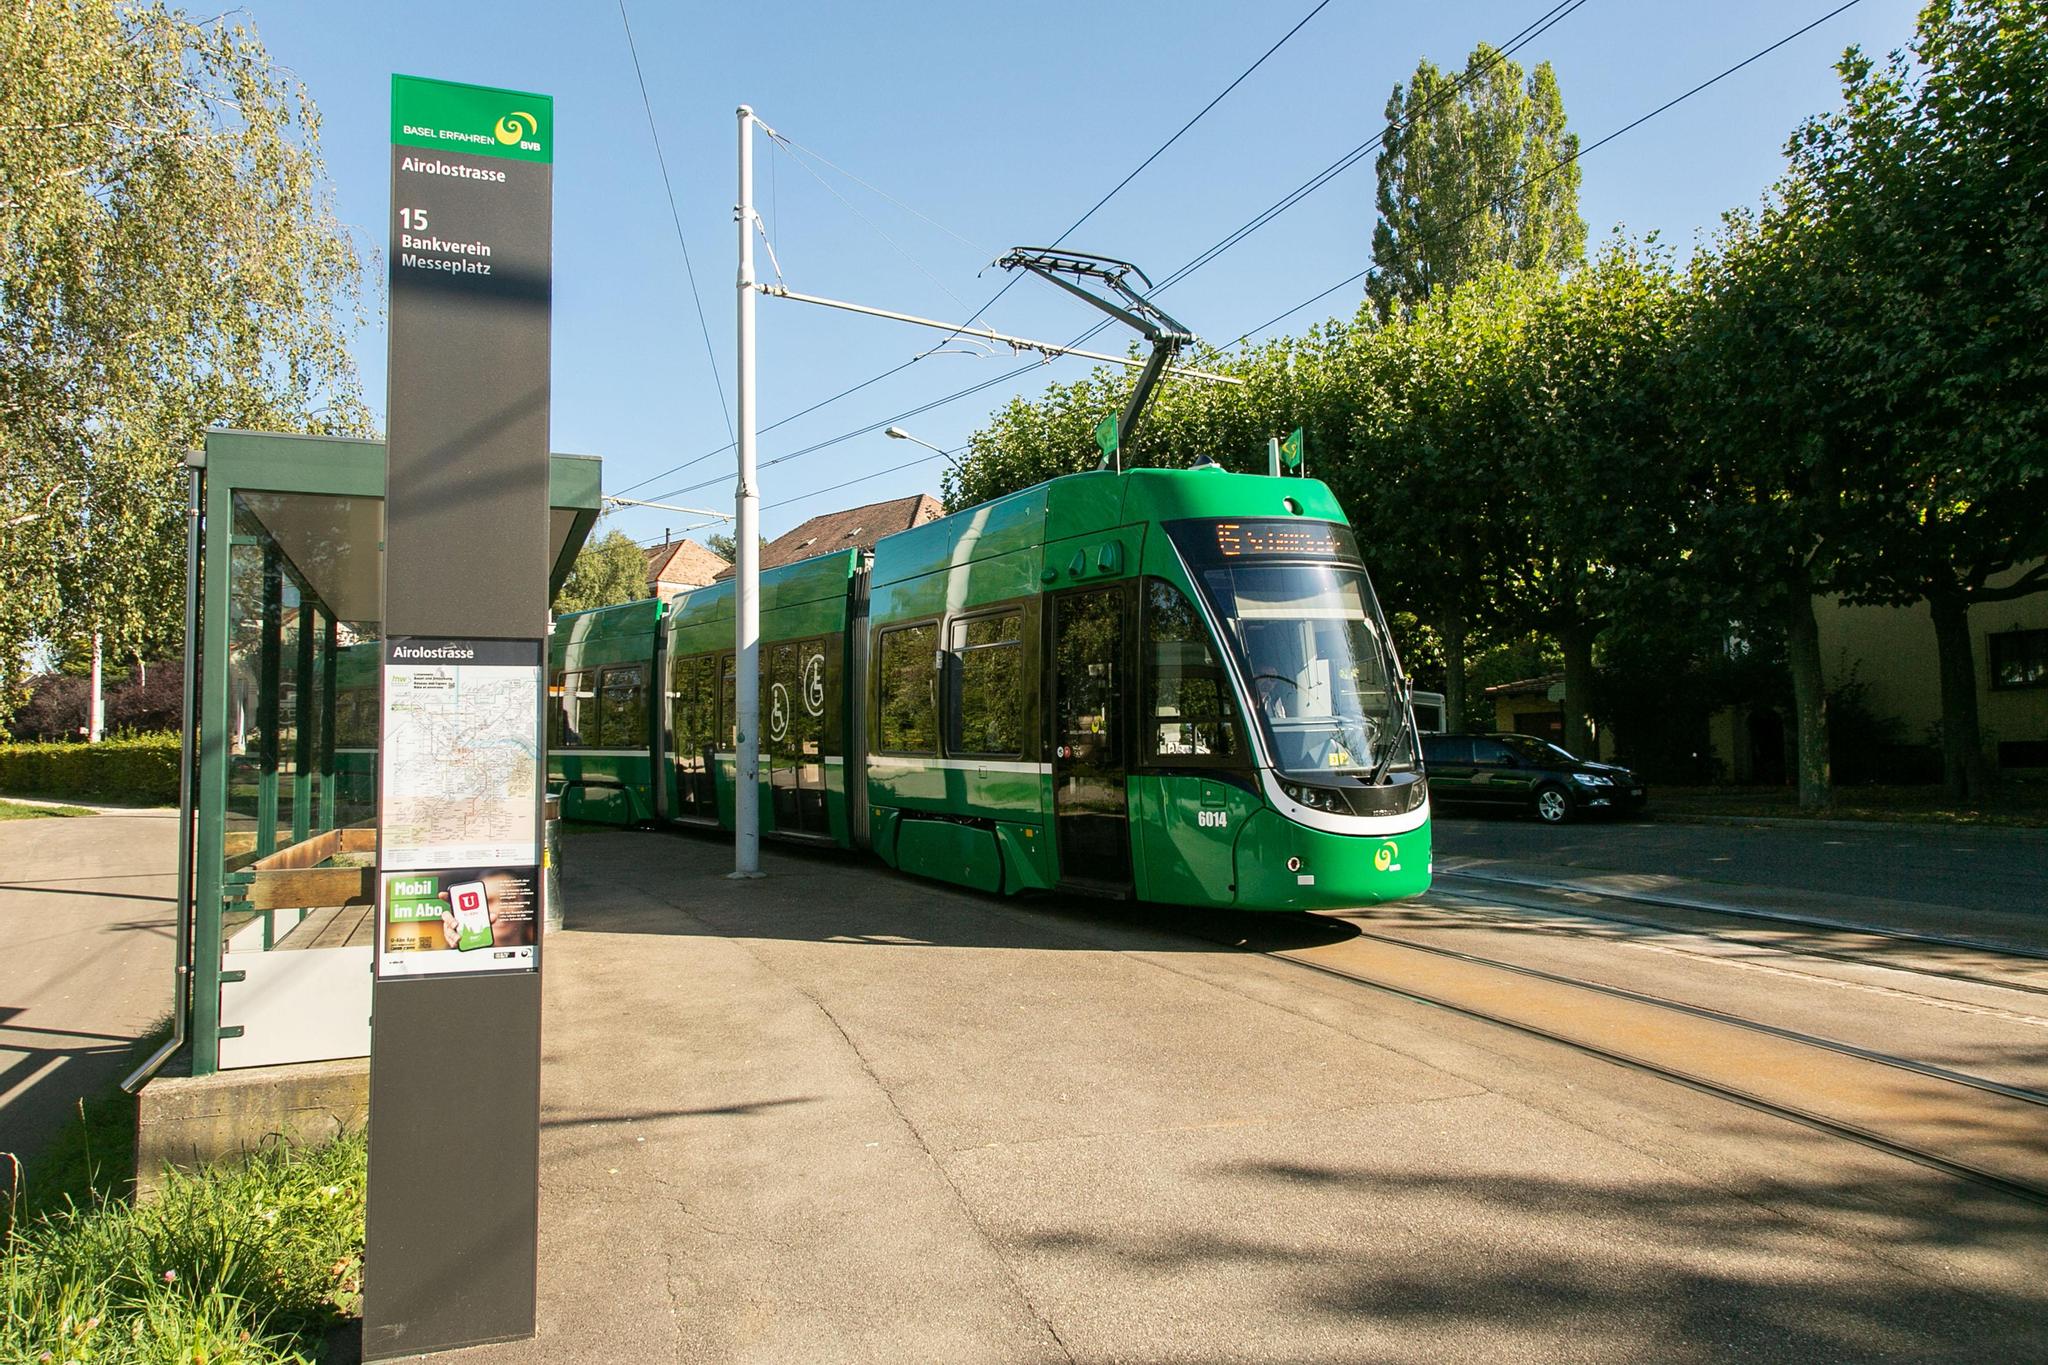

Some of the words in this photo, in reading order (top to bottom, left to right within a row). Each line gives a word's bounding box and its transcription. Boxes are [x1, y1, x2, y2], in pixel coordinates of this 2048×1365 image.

[403, 125, 437, 139] BASEL
[439, 130, 495, 145] ERFAHREN
[520, 140, 541, 152] BVB
[401, 157, 506, 183] Airolostrasse
[400, 207, 429, 231] 15
[402, 234, 491, 257] Bankverein
[402, 253, 491, 275] Messeplatz
[393, 646, 474, 659] Airolostrasse
[1198, 811, 1228, 828] 6014
[394, 880, 432, 896] Mobil
[394, 903, 412, 918] im
[415, 902, 443, 918] Abo
